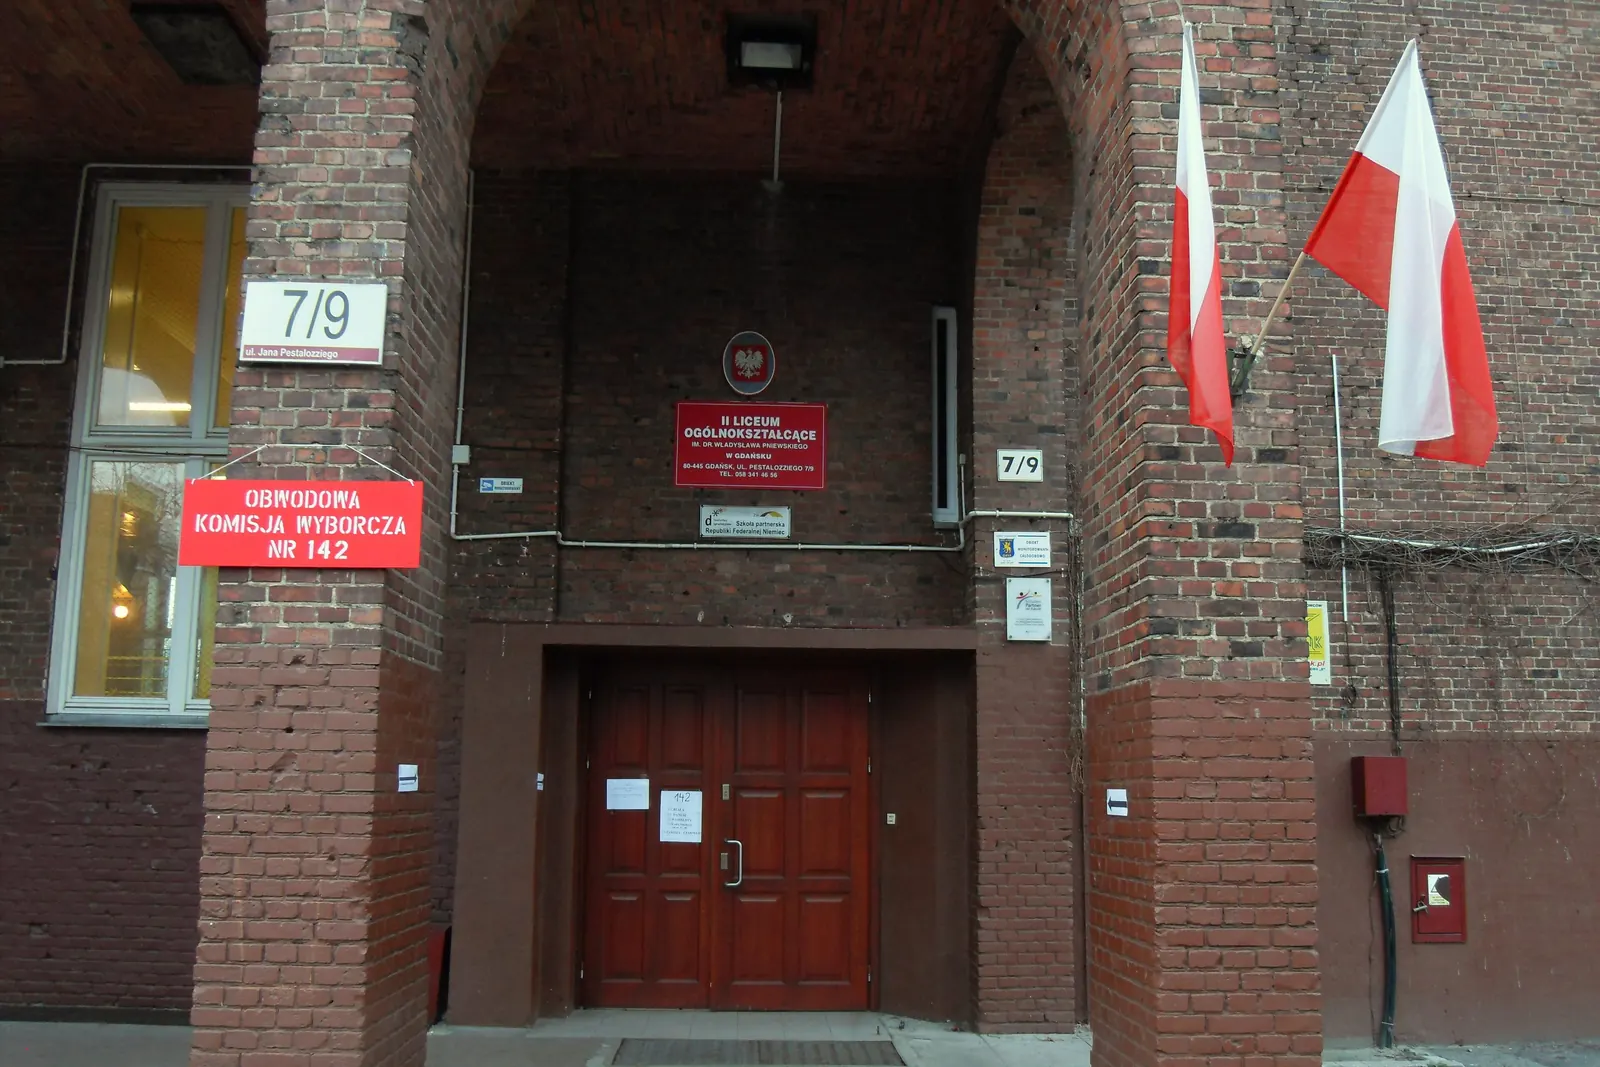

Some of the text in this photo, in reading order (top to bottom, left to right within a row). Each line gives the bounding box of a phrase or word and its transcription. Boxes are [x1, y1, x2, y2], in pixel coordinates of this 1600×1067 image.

[284, 290, 350, 340] 7/9
[246, 348, 338, 360] ul. Jana Pestalozziego
[722, 416, 780, 427] II LICEUM
[684, 426, 816, 442] OGÓLNOKSZTAŁCĄCE
[1002, 456, 1039, 475] 7/9
[245, 489, 360, 509] OBWODOWA
[195, 514, 406, 535] KOMISJA WYBORCZA
[268, 540, 349, 560] NR 142
[674, 793, 690, 802] 142
